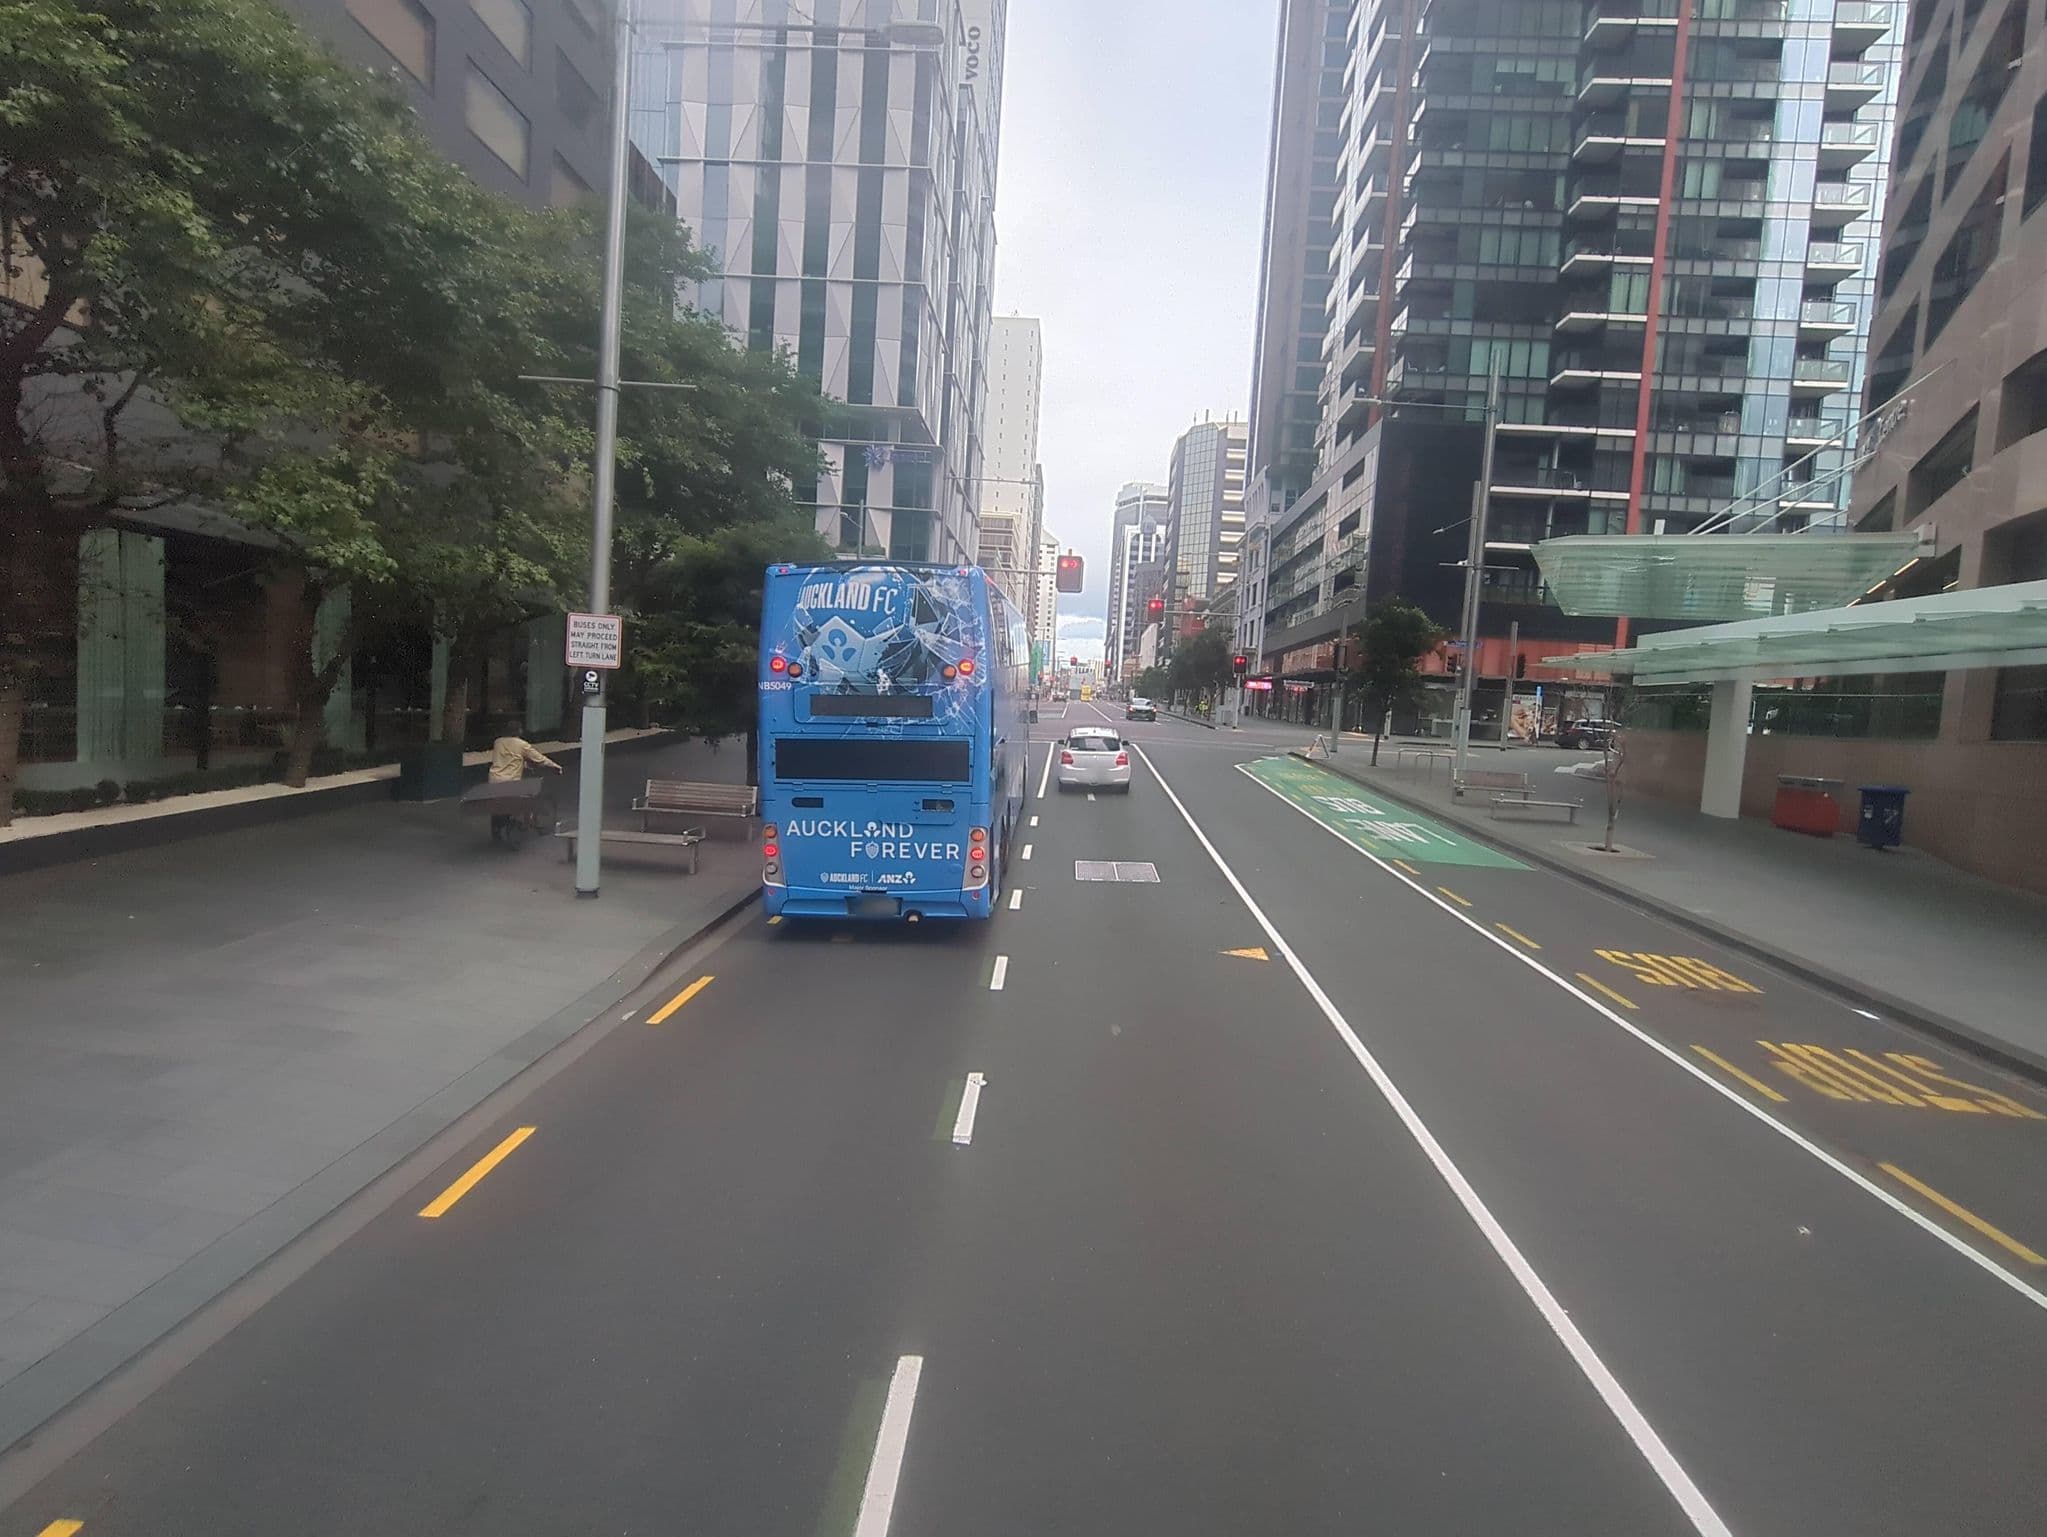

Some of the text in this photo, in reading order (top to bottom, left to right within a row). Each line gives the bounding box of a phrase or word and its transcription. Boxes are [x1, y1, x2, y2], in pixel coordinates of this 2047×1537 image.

[872, 586, 899, 616] FC
[574, 621, 595, 629] BUSES
[587, 632, 617, 640] PROCEED
[571, 641, 599, 649] STRAIGHT
[602, 653, 616, 661] LANE
[1311, 795, 1385, 815] BUS
[1344, 818, 1456, 846] LANE
[829, 873, 903, 884] AUCKLAND FC ANZ
[1593, 948, 1766, 994] BUS
[1755, 1039, 2047, 1120] STOP
